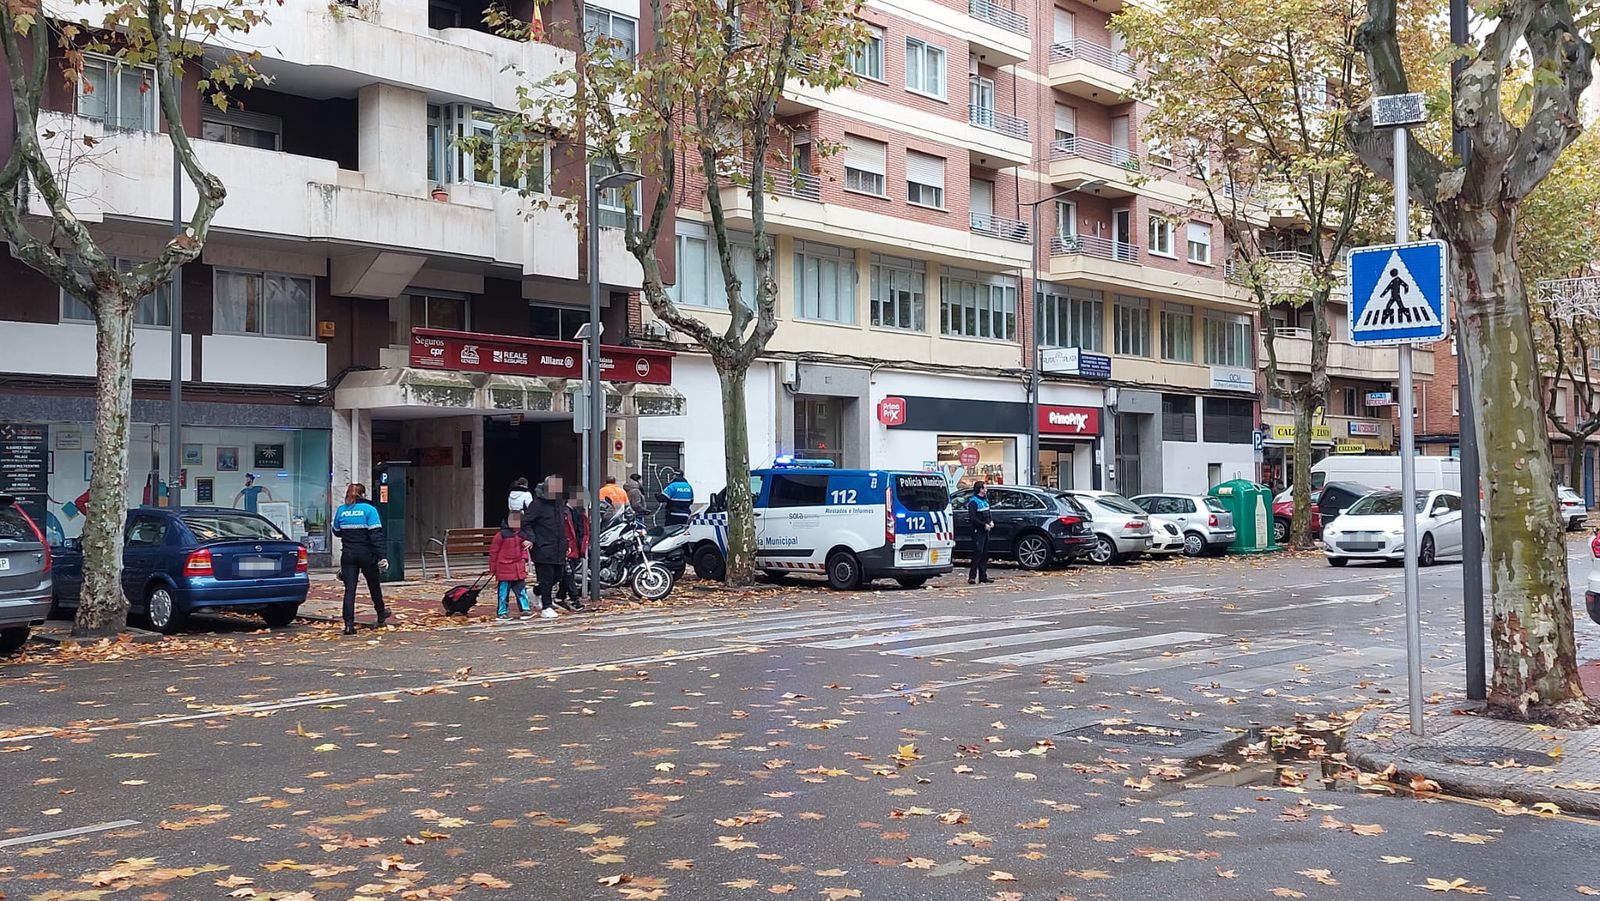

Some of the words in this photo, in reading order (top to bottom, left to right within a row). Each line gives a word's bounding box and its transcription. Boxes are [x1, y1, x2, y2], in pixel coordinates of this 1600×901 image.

[415, 336, 444, 347] Seguros
[430, 347, 444, 356] cpr
[540, 355, 564, 366] Allianz
[382, 472, 388, 483] P
[831, 489, 857, 504] 112
[906, 516, 926, 530] 112
[765, 535, 799, 547] Municipal
